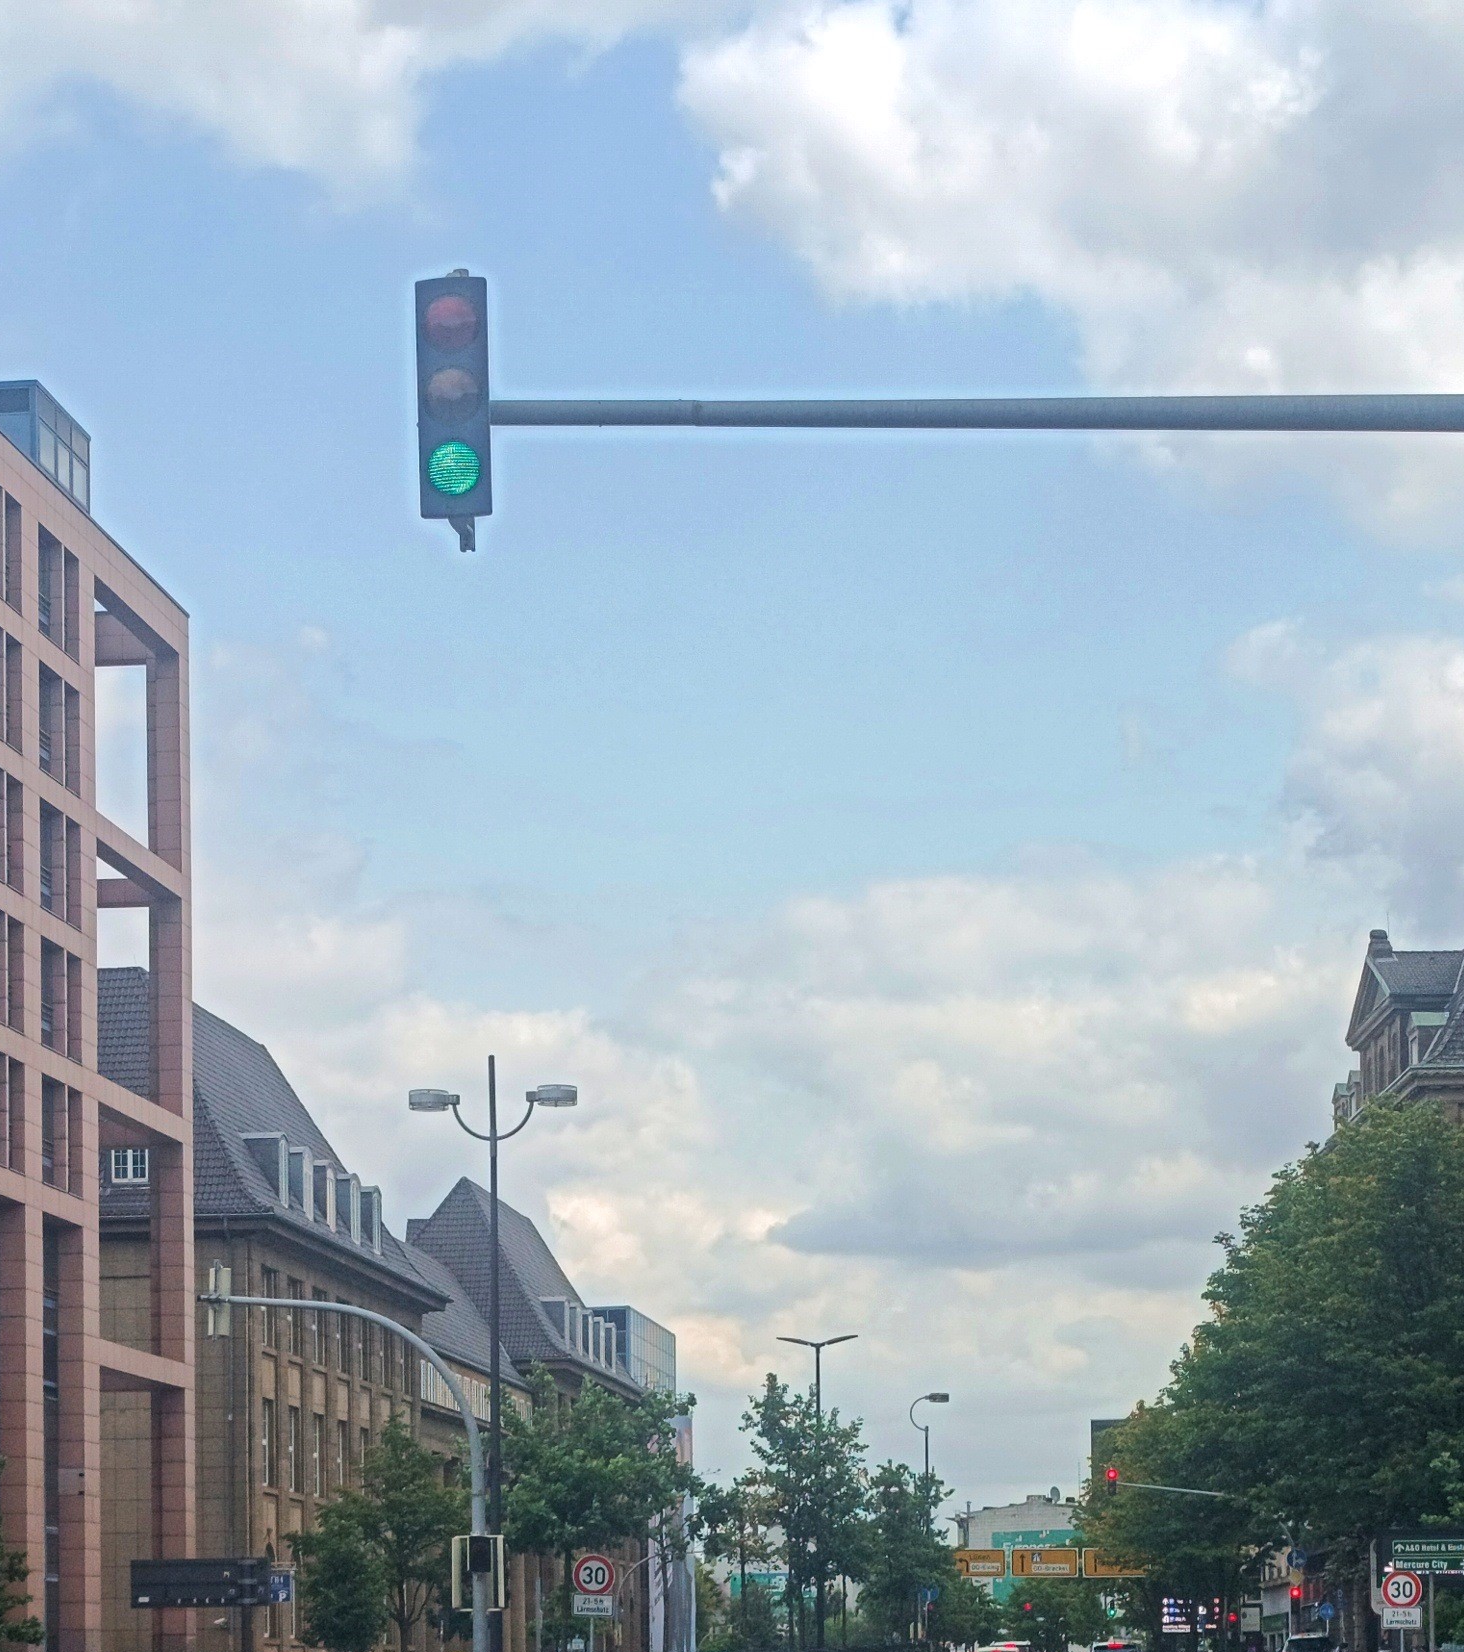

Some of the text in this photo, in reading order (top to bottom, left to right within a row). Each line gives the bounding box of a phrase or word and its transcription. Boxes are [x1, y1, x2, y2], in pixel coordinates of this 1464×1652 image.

[1395, 1559, 1449, 1571] Mercure City
[582, 1566, 606, 1585] 30
[1390, 1581, 1413, 1599] 30
